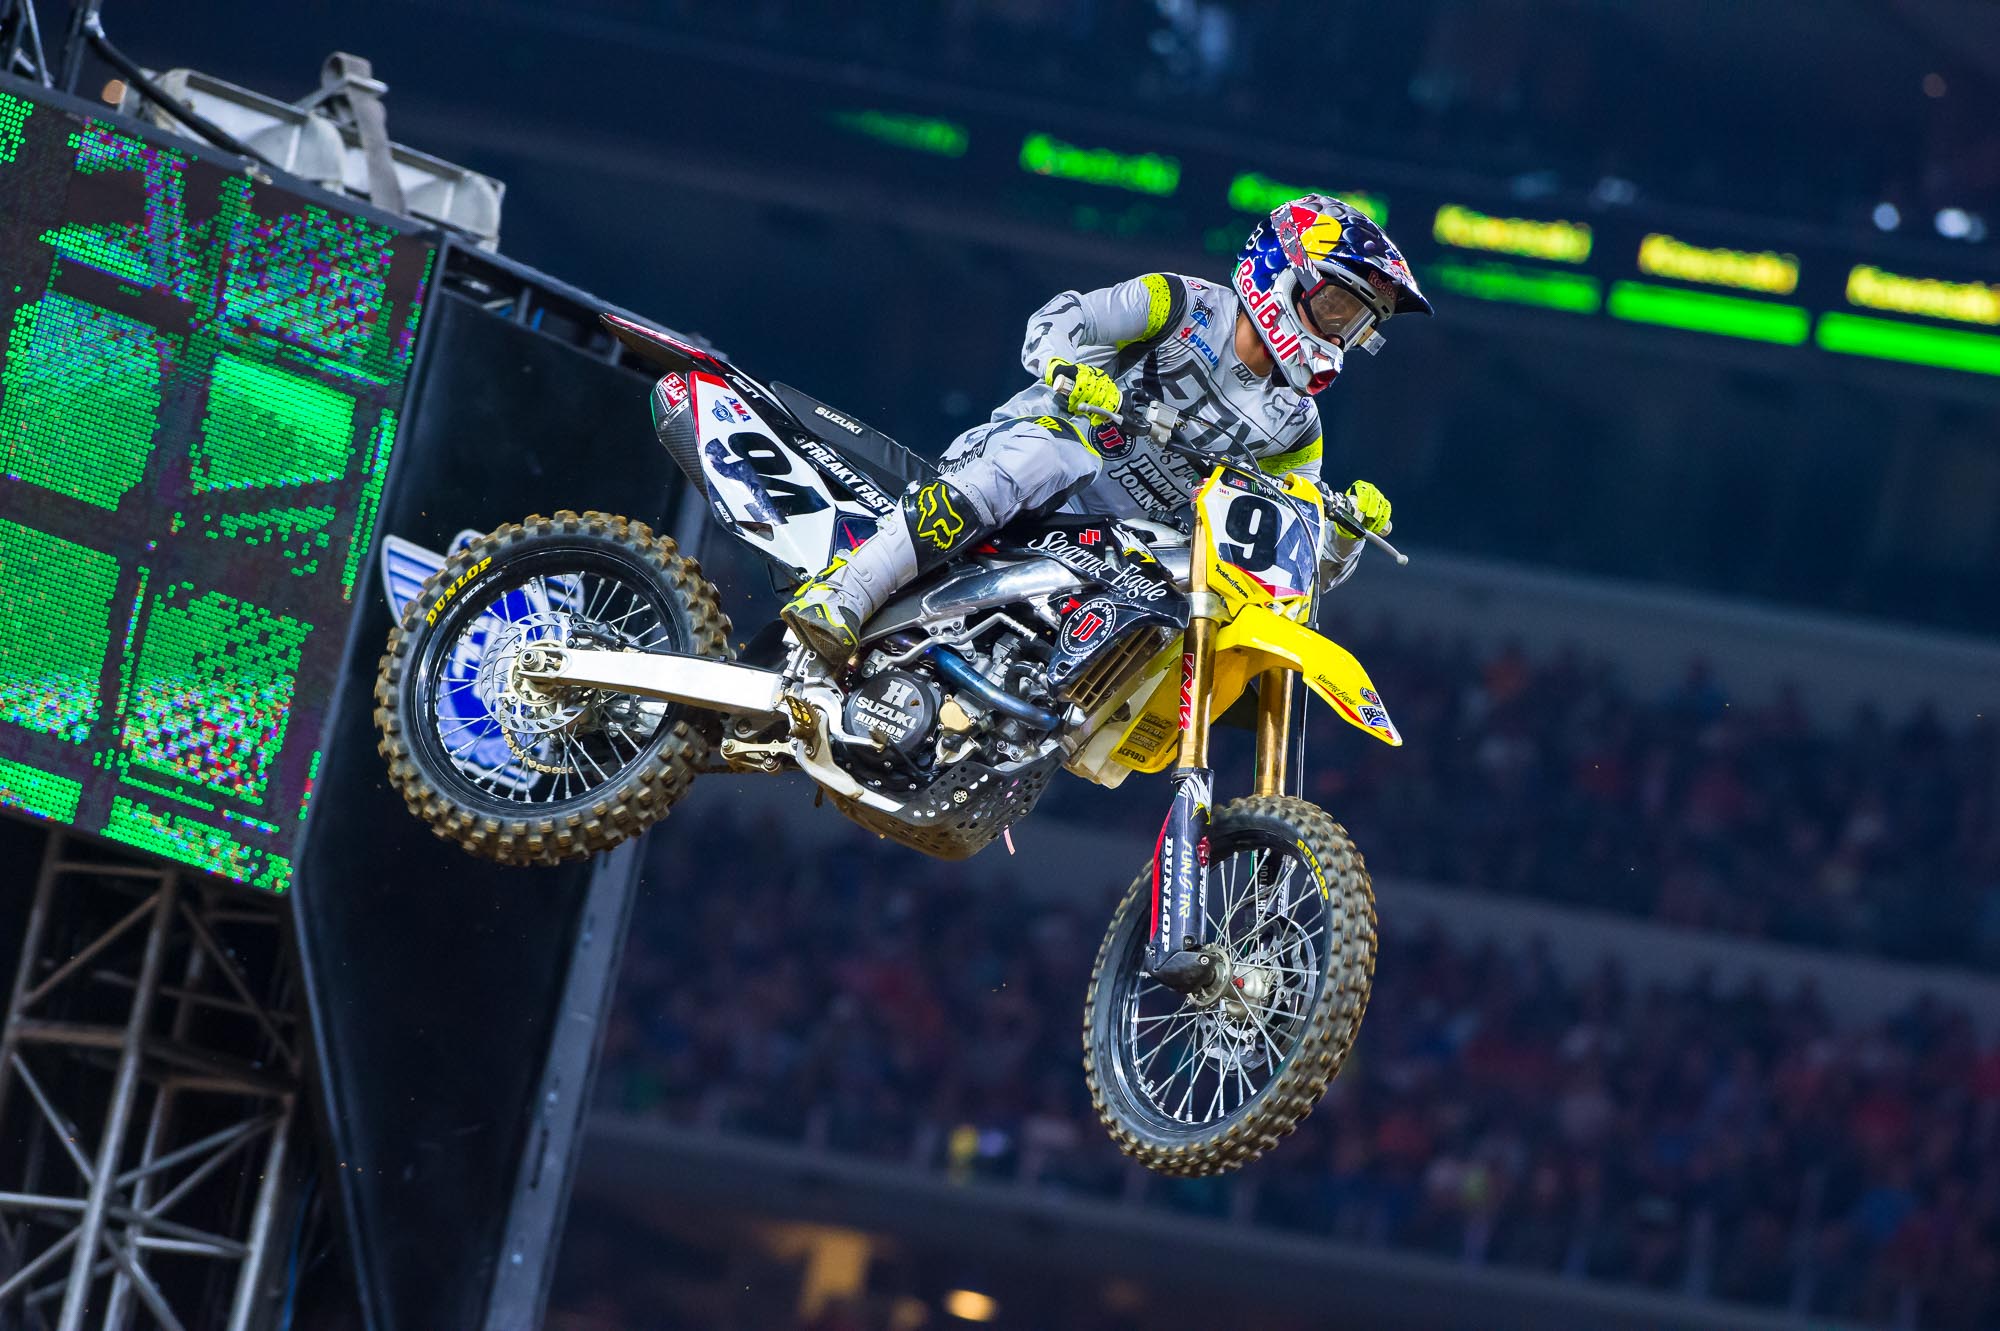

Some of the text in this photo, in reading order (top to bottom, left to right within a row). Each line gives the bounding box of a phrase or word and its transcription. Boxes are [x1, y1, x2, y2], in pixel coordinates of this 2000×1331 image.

[1234, 256, 1302, 362] Red Bull
[814, 405, 864, 435] SUZUKI
[800, 441, 898, 515] FREAKY FAST
[1129, 454, 1189, 512] JIMMY
[425, 555, 493, 628] DUNLOP
[1111, 562, 1168, 602] Eagle
[854, 711, 906, 739] HINSON
[855, 696, 918, 730] SUZUKI
[1161, 835, 1174, 953] DUNLOP
[1296, 838, 1330, 901] DUNLOP
